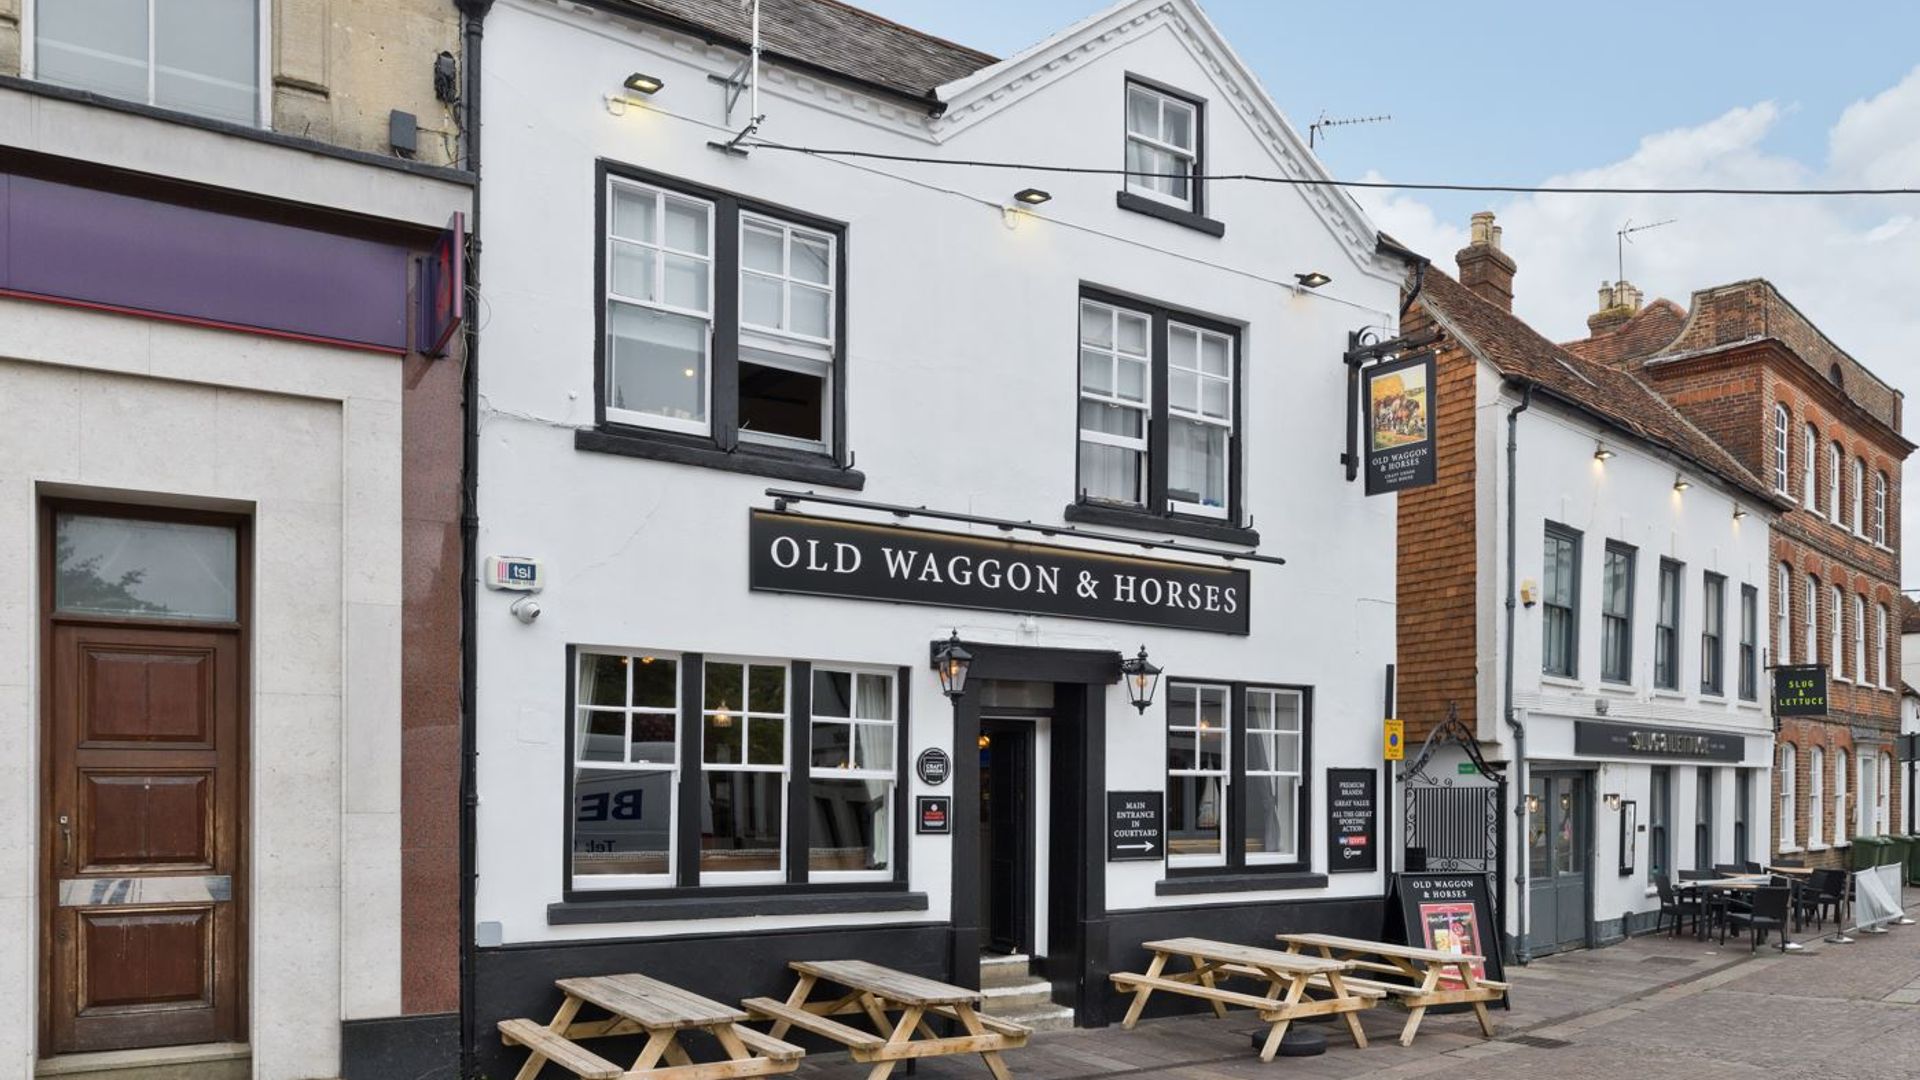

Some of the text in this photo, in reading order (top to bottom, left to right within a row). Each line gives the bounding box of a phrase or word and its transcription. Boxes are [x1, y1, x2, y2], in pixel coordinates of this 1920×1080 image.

[1372, 448, 1428, 466] OLD WAGGON
[1380, 458, 1420, 472] & HORSES
[770, 536, 1238, 614] OLD WAGGON & HORSES
[1788, 680, 1814, 689] SLUG
[1779, 697, 1824, 706] LETTUCE
[1126, 801, 1146, 810] MAIN
[1116, 811, 1155, 819] ENTRANCE
[1131, 820, 1140, 828] IN
[1113, 829, 1158, 838] COURTYARD
[1412, 880, 1474, 889] OLD WAGGON
[1423, 890, 1467, 899] & HORSES
